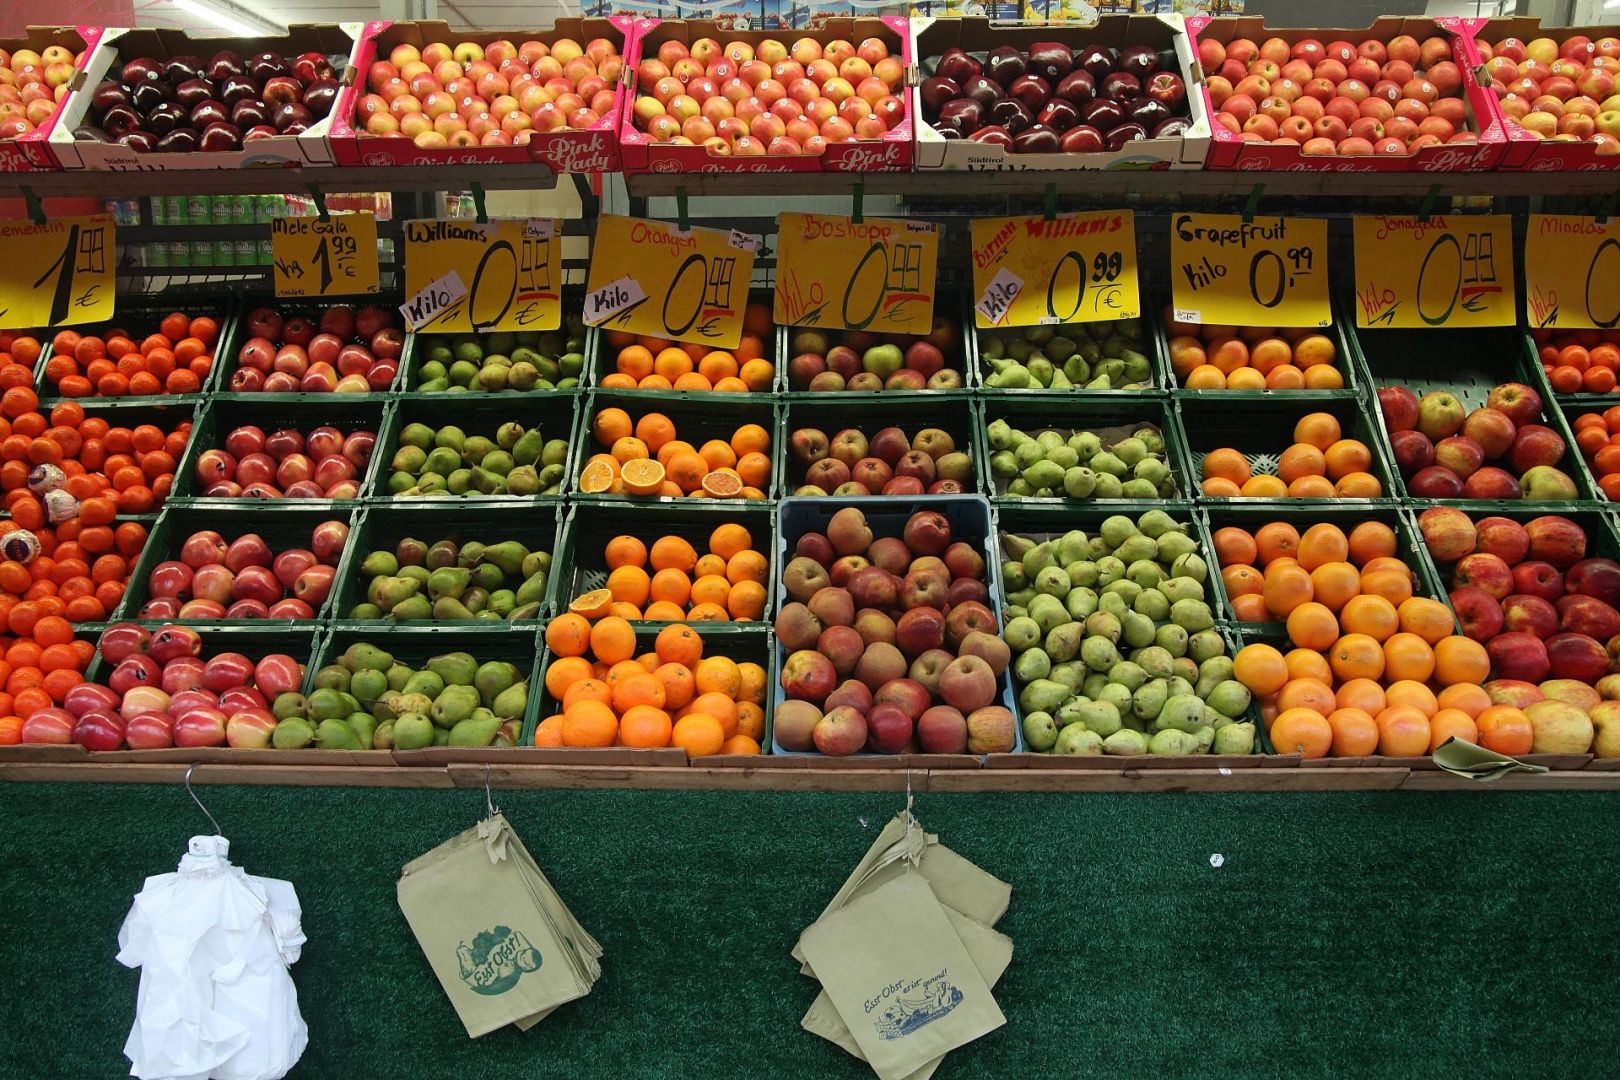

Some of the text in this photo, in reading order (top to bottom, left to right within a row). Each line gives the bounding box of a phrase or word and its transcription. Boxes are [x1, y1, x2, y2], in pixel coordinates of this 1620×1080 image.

[549, 133, 605, 161] Pink
[839, 143, 900, 171] Pink
[563, 153, 609, 173] Lady
[273, 217, 348, 235] Mele Gala
[407, 223, 488, 243] Williams
[631, 222, 697, 256] Orangen
[1024, 215, 1123, 239] Williams
[1176, 215, 1287, 248] Grapefruit
[1540, 218, 1607, 235] Minolas
[332, 236, 357, 255] 99
[972, 221, 1017, 269] Birnen
[1286, 246, 1313, 270] 99
[33, 224, 105, 326] 1 99
[1091, 251, 1123, 283] 99
[1417, 232, 1496, 326] 0 99
[75, 285, 101, 306] €
[469, 238, 551, 332] 0 99
[662, 254, 736, 337] 0 99
[842, 242, 922, 330] 0 99
[1103, 289, 1123, 308] €
[408, 290, 450, 322] Kilo
[514, 301, 545, 326] €
[594, 286, 630, 313] Kilo
[881, 299, 915, 323] €
[984, 282, 1018, 320] Kilo
[1461, 292, 1489, 313] €
[695, 317, 724, 338] €
[474, 933, 521, 986] Esst Obst!
[863, 994, 881, 1013] Esst
[882, 979, 905, 998] Obst
[911, 978, 922, 991] ist
[923, 968, 947, 990] gesund!
